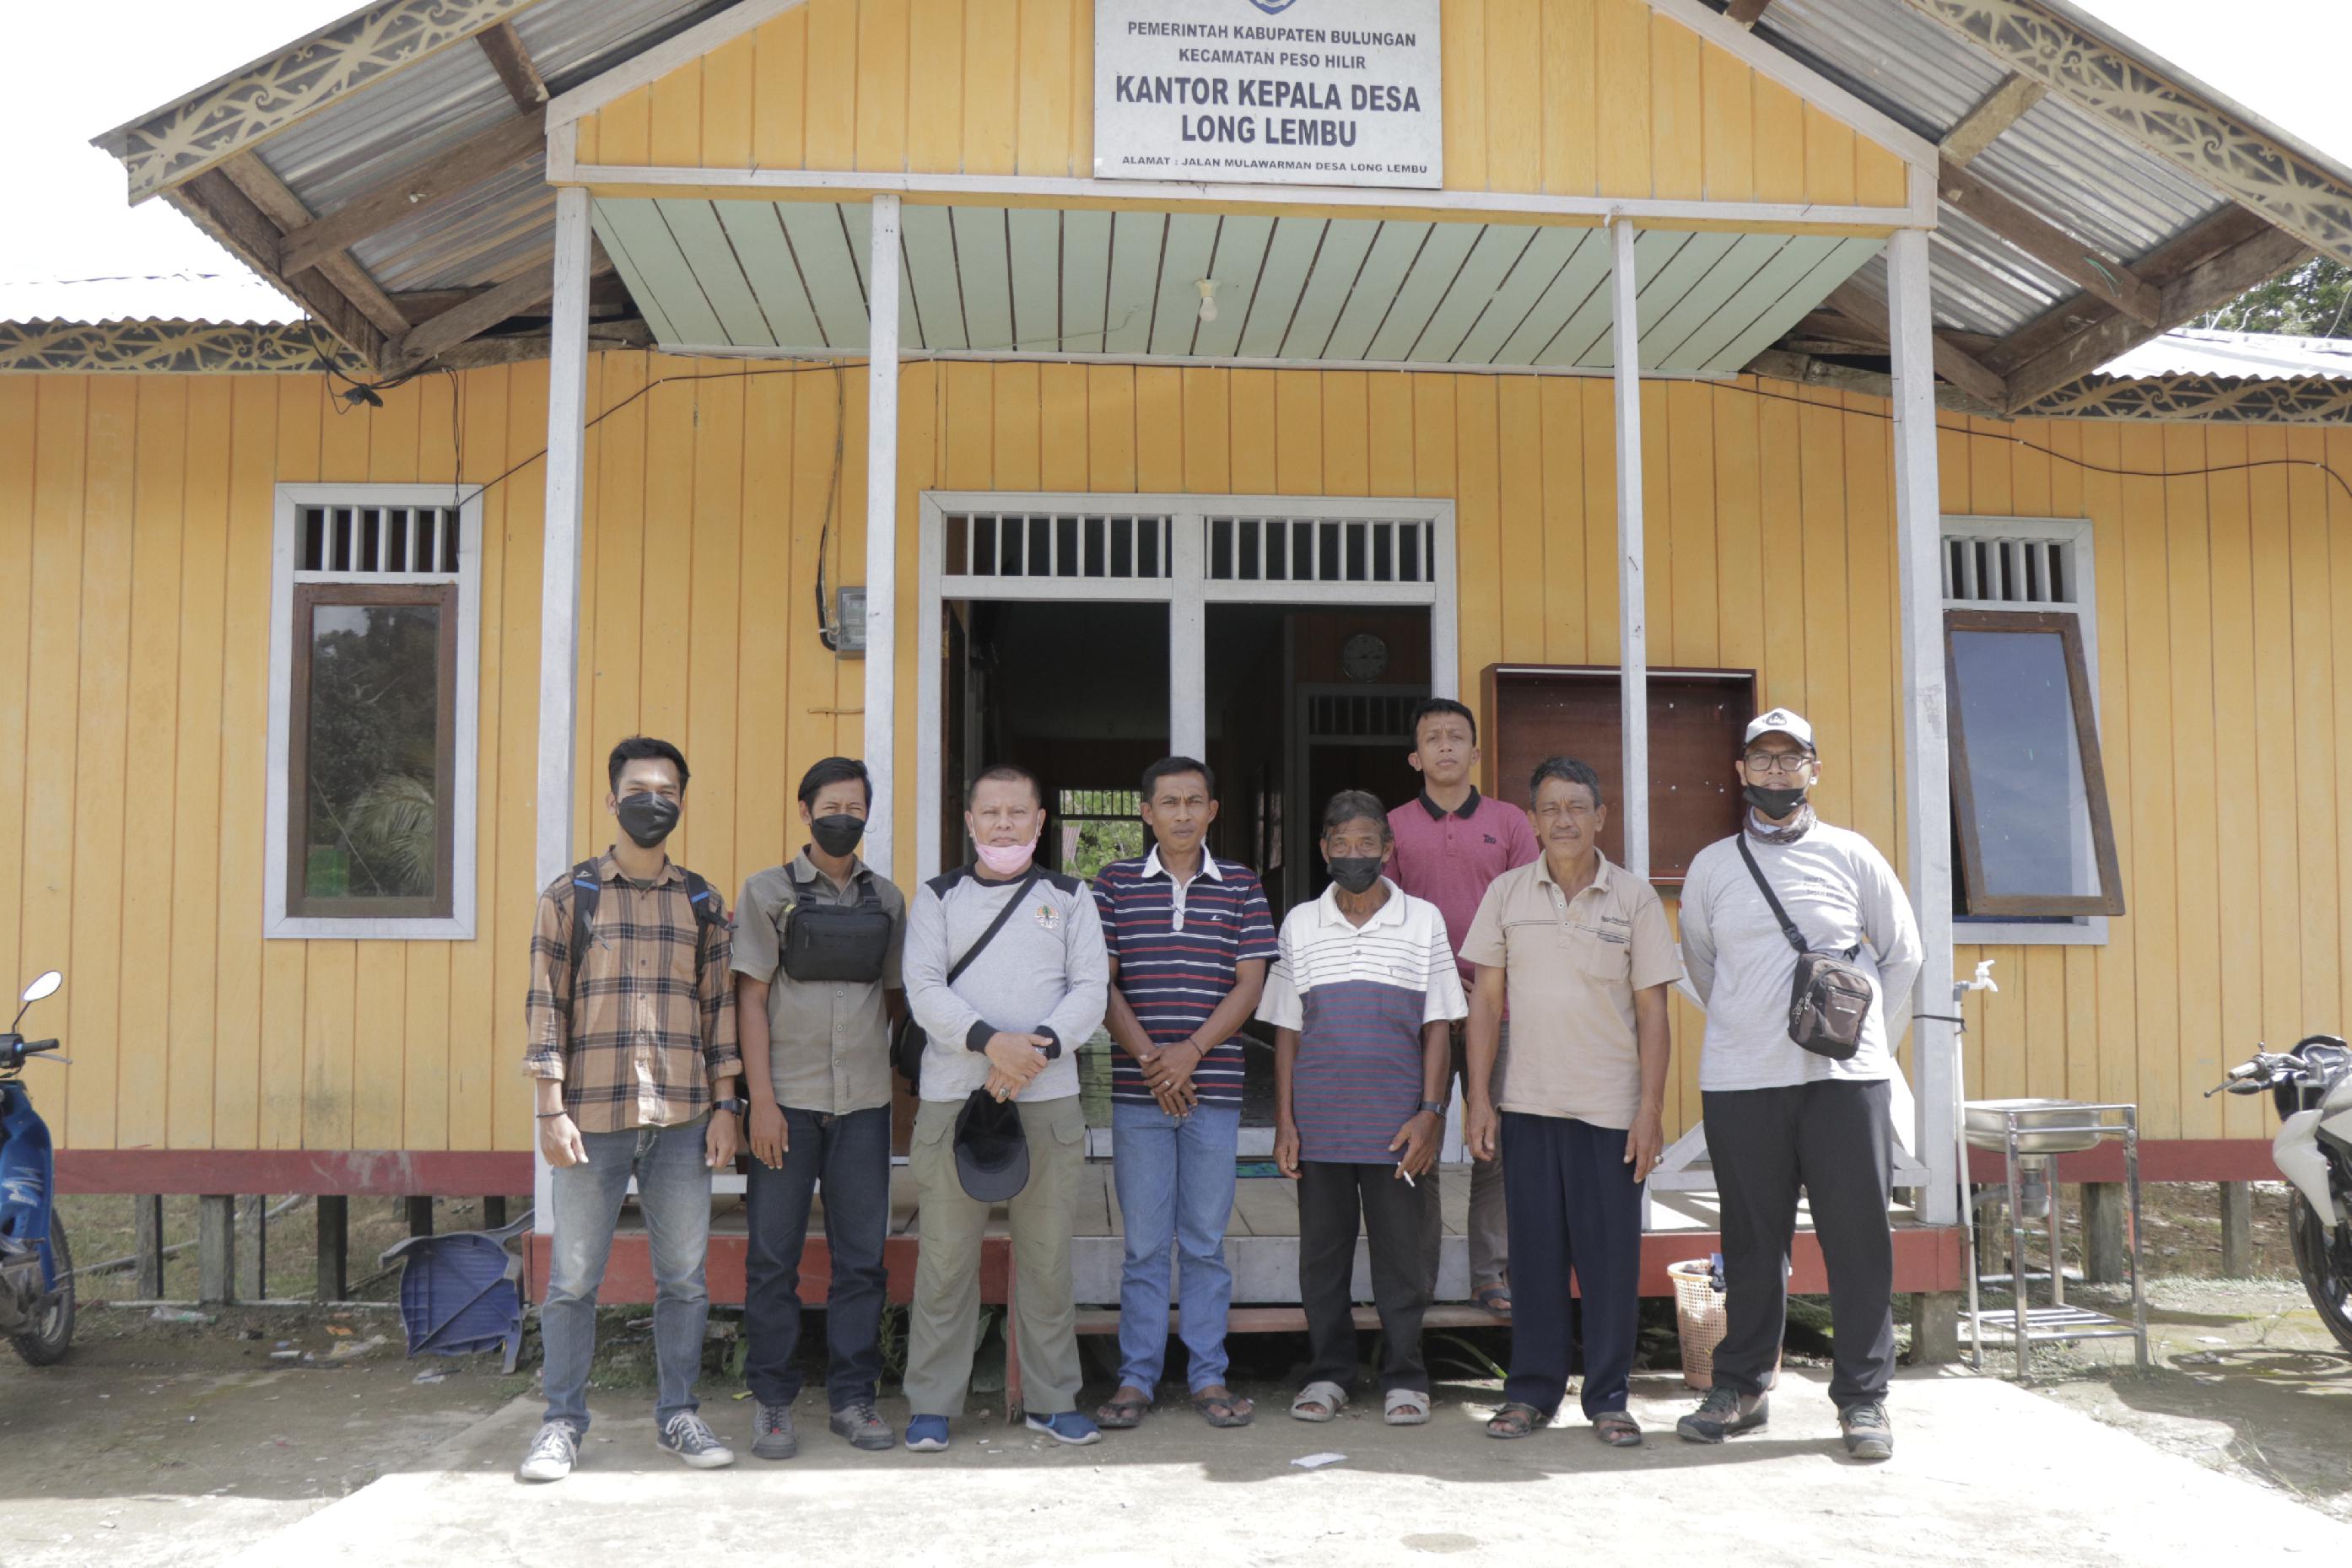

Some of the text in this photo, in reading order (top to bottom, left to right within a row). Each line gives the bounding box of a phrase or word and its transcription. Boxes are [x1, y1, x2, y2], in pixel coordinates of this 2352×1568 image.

[1128, 21, 1416, 46] PEMERINTAH KABUPATEN BULUNGAN
[1179, 48, 1366, 69] KECAMATAN PESO HILIR
[1116, 75, 1421, 112] KANTOR KEPALA DESA
[1182, 115, 1356, 147] LONG LEMBU
[1122, 156, 1171, 165] ALAMAT
[1181, 158, 1221, 168] JALAN
[1224, 158, 1312, 170] MULAWARMAN
[1315, 162, 1347, 171] DESA
[1350, 163, 1383, 173] LONG
[1387, 164, 1427, 174] LEMBU
